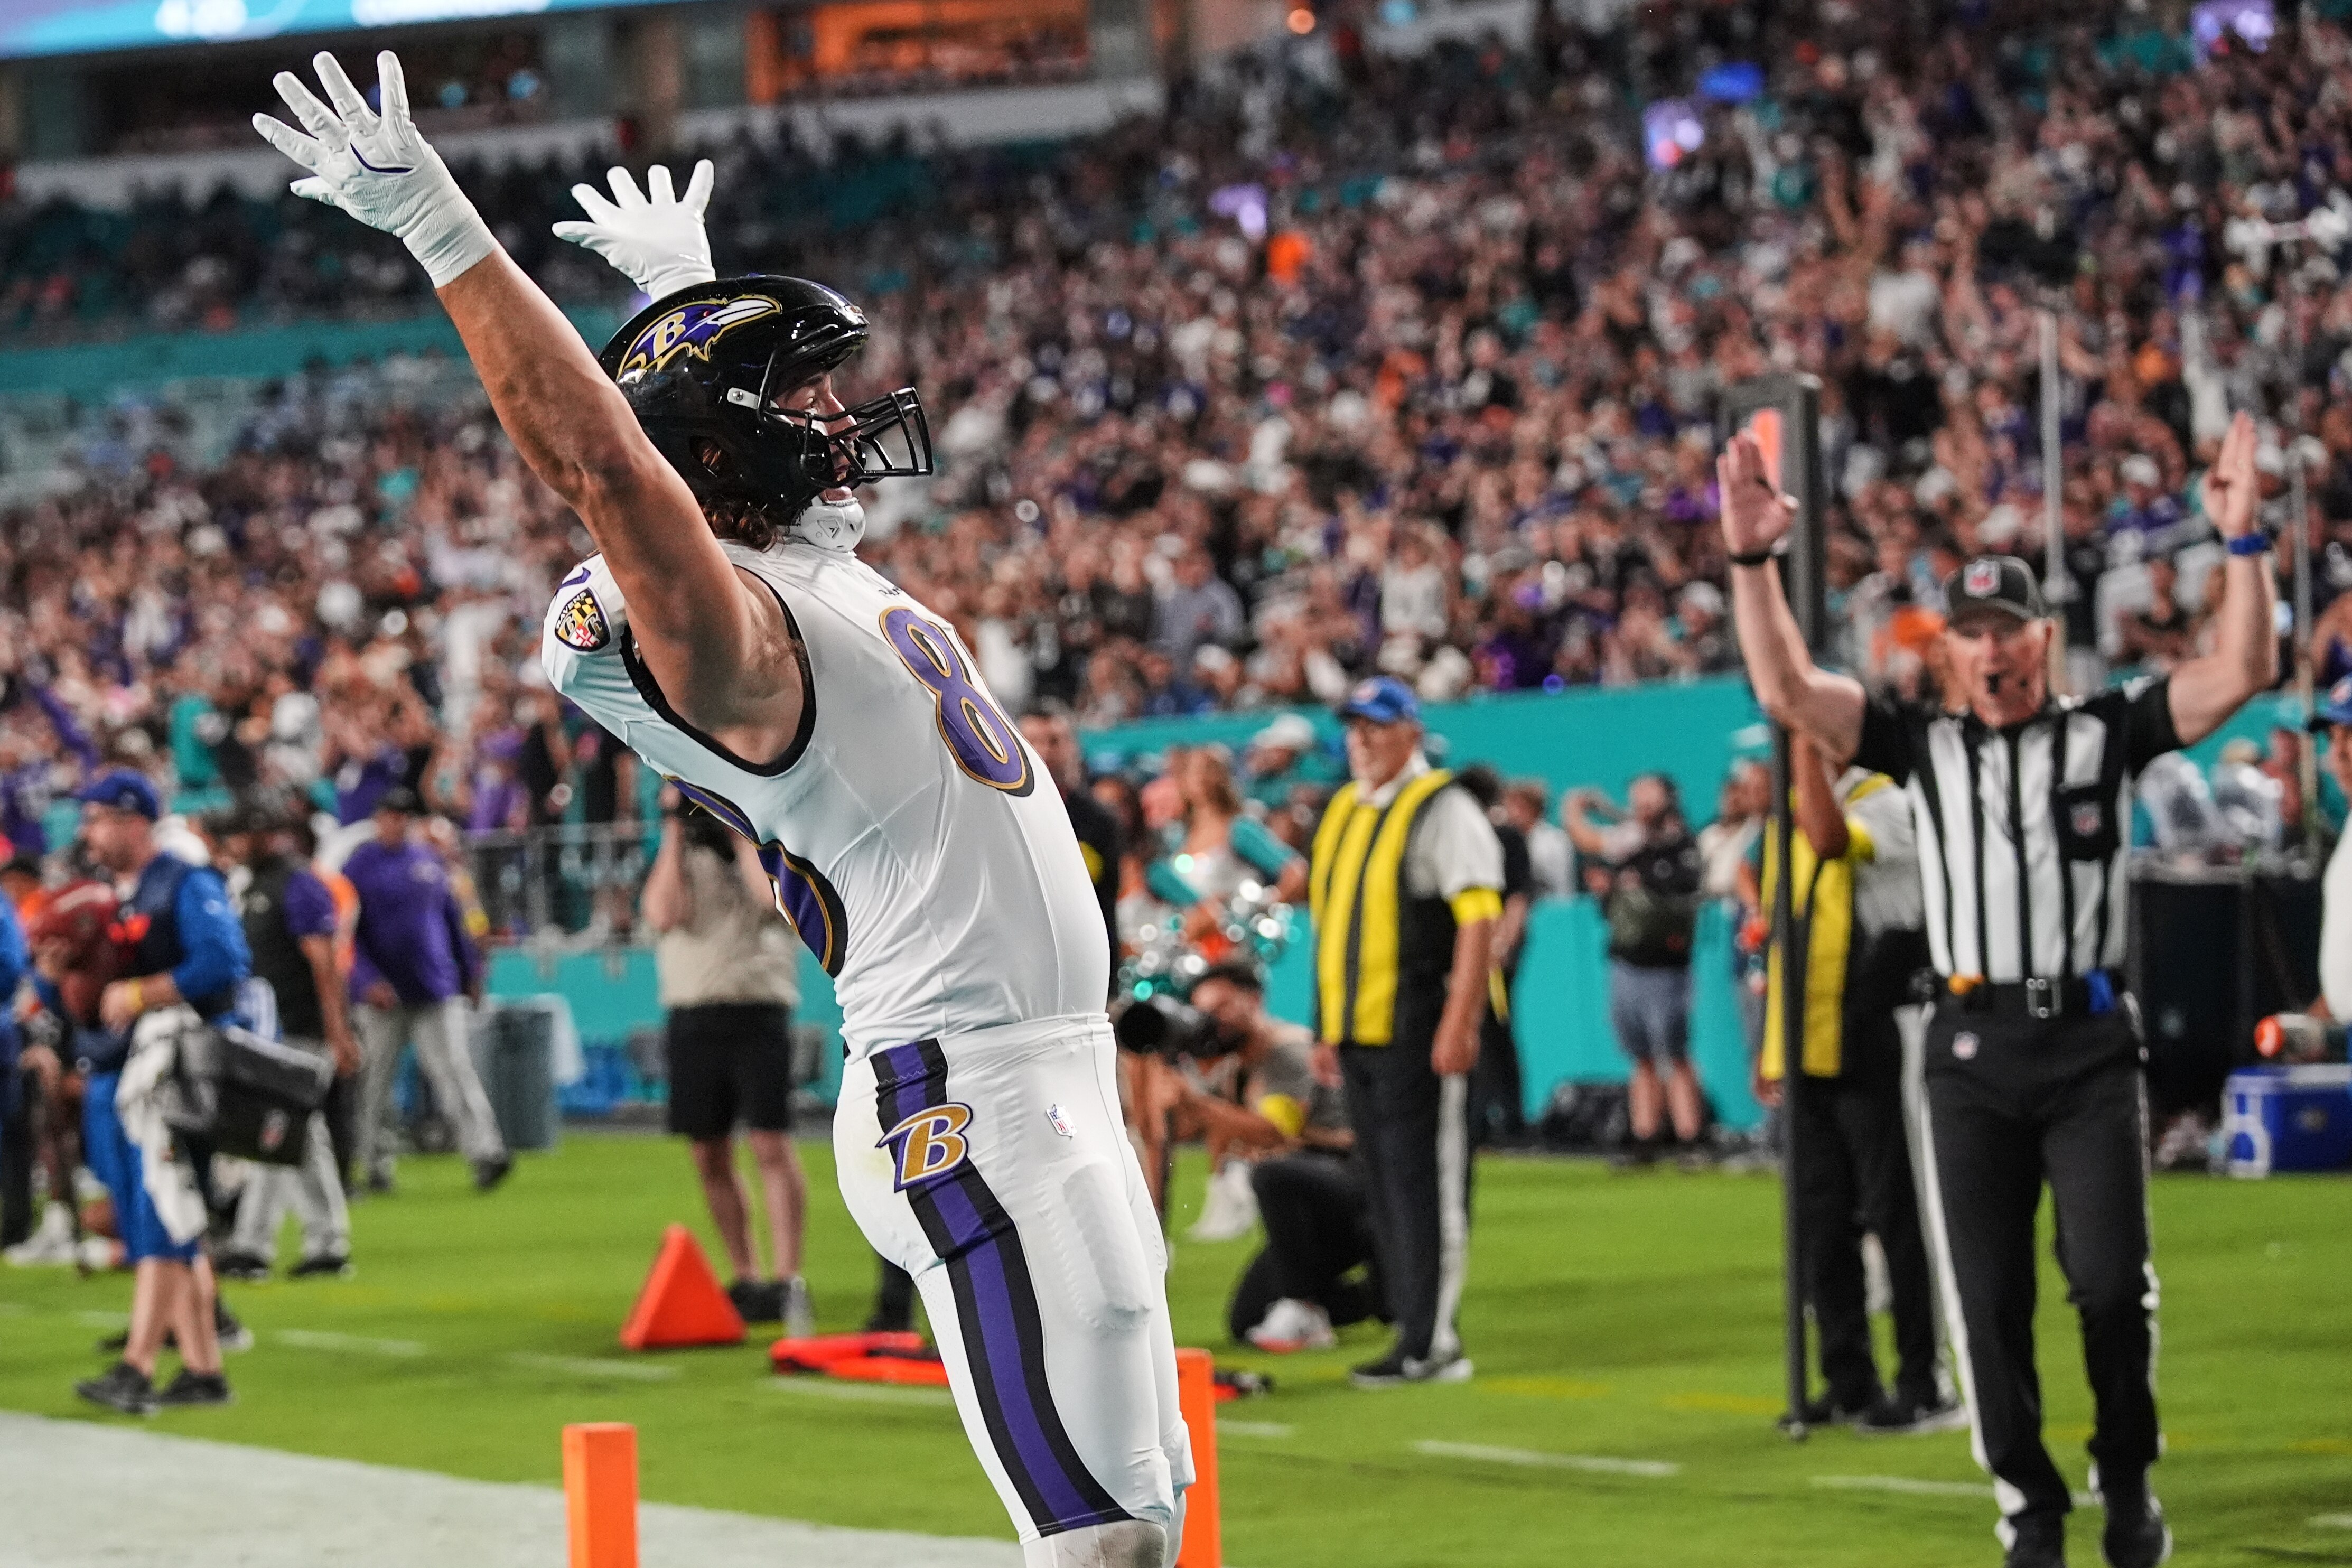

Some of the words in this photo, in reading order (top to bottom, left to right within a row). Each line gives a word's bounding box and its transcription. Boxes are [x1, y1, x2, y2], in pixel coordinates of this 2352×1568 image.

[635, 311, 686, 360] B
[556, 591, 587, 629] RAVENS
[879, 605, 1035, 797] 8
[875, 1102, 973, 1193] B
